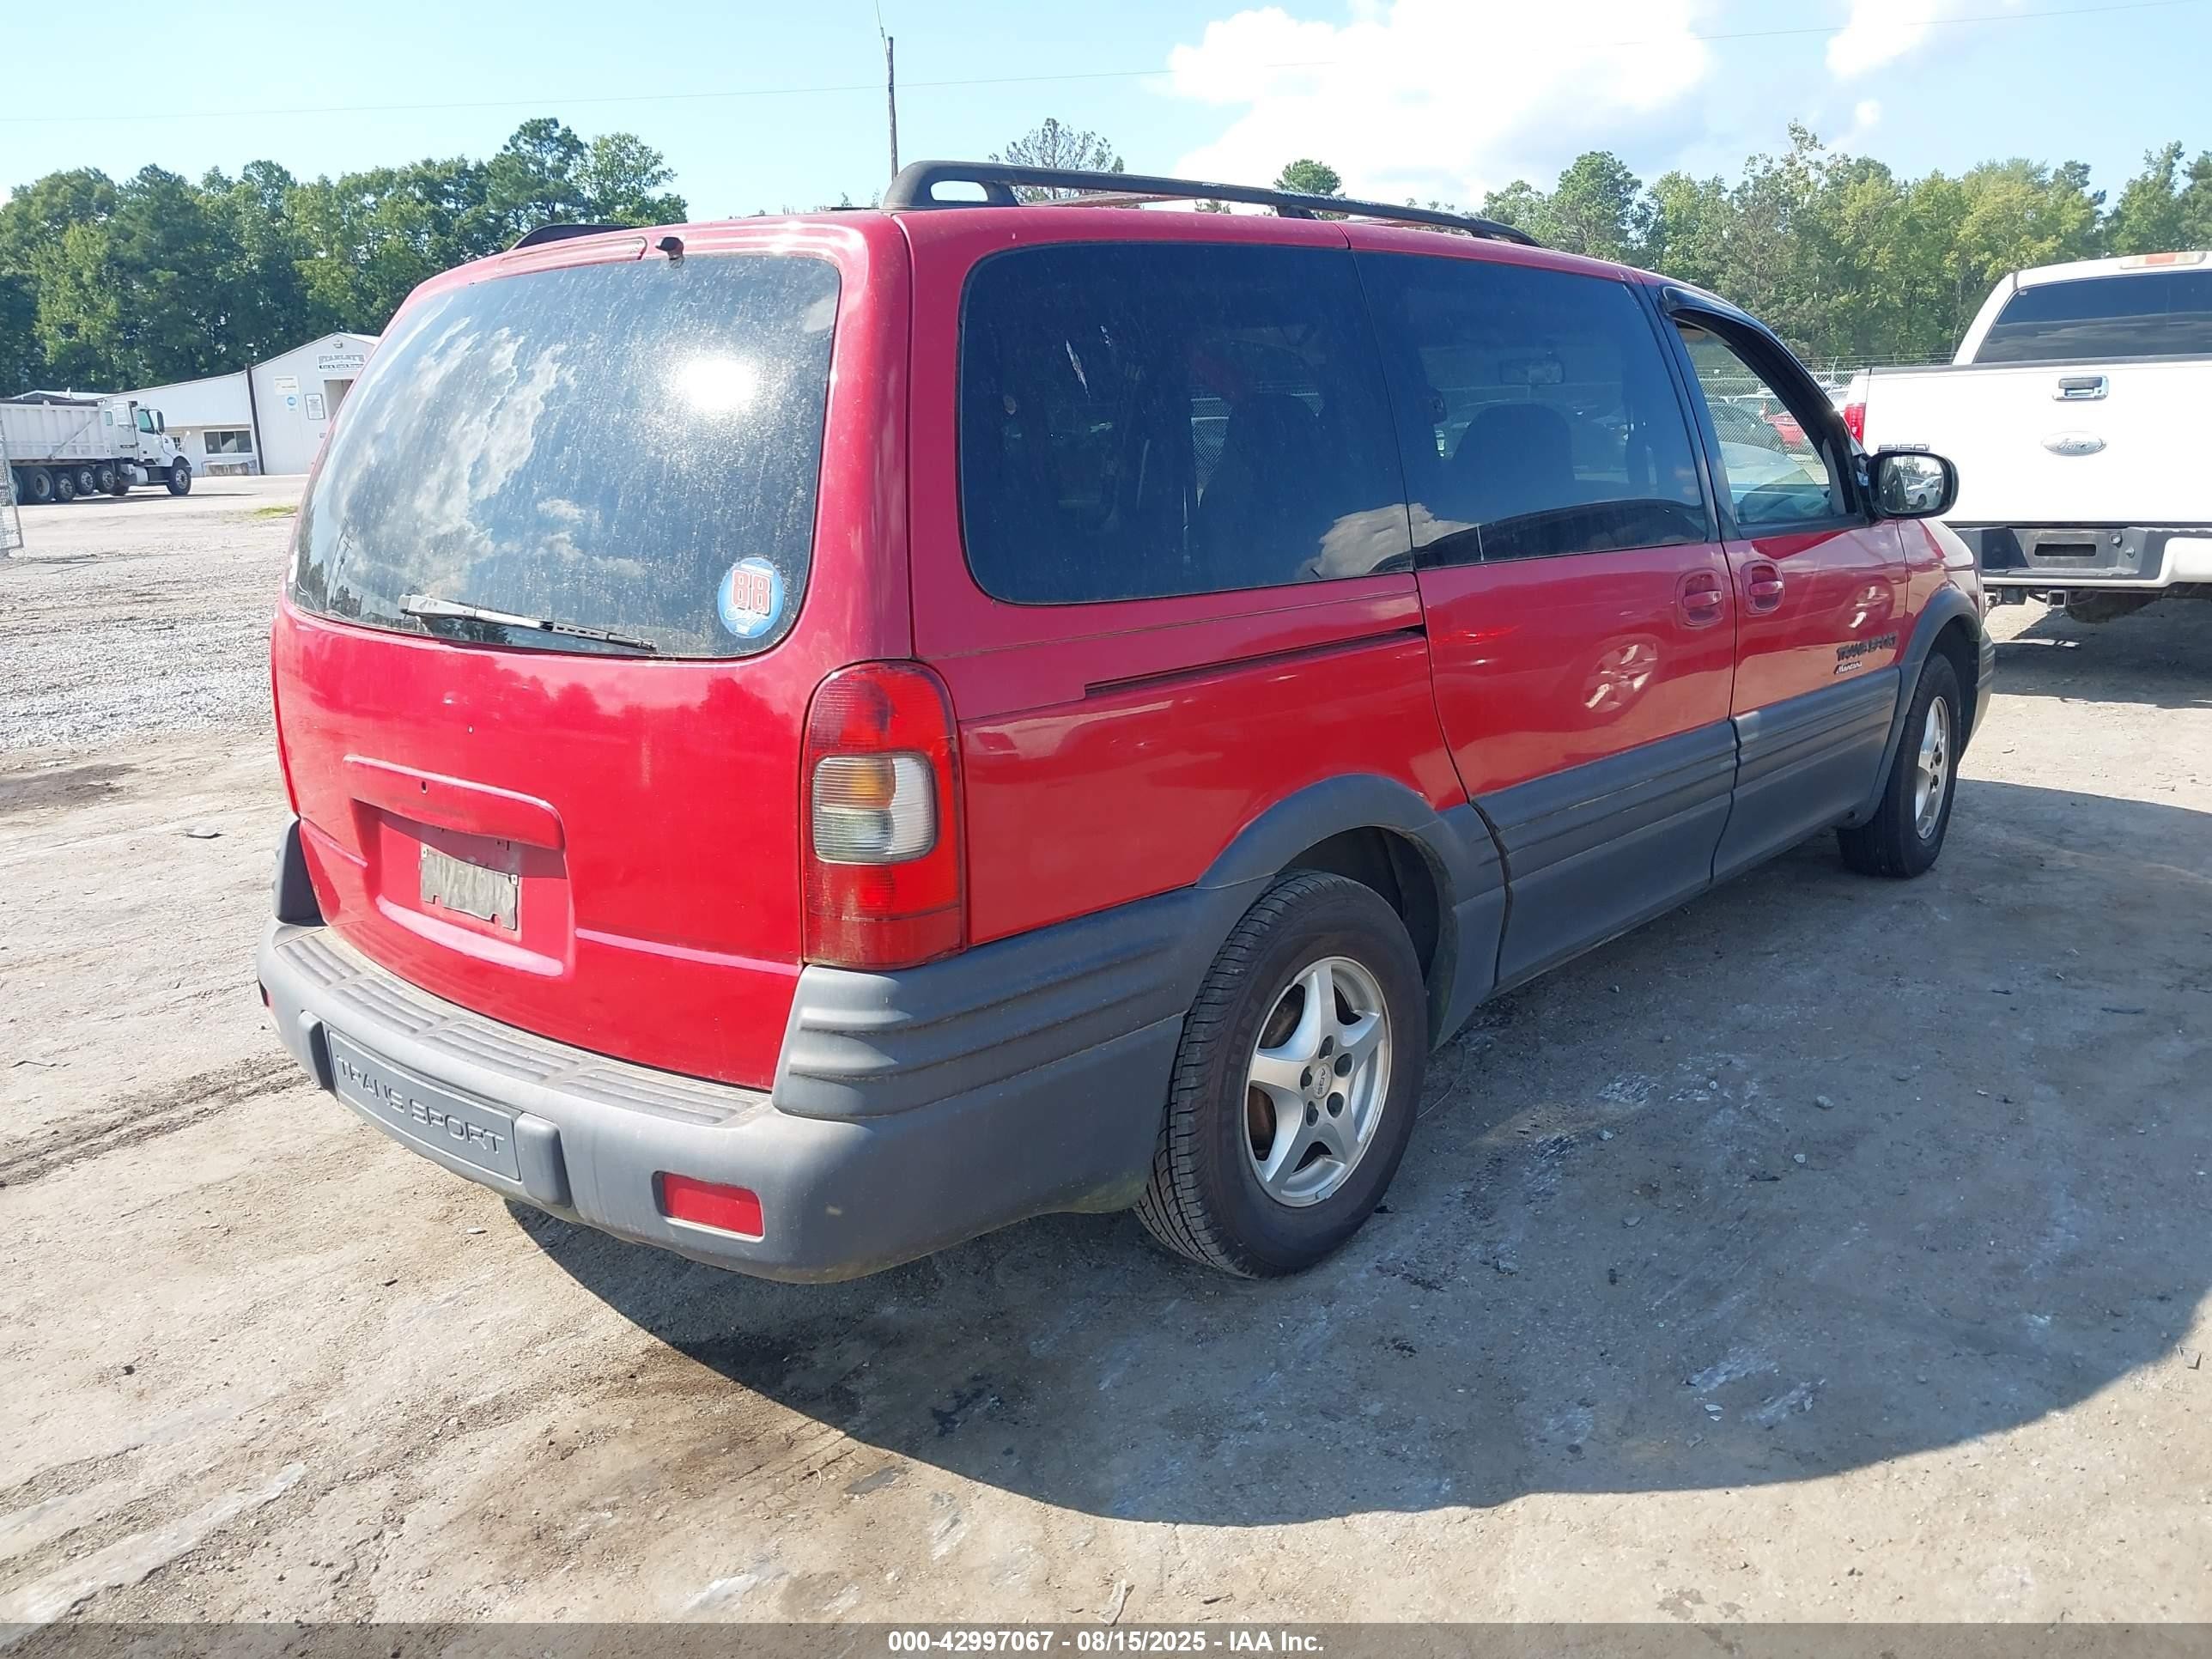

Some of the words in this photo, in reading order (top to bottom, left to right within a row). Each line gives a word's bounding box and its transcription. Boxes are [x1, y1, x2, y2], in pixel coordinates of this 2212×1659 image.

[731, 569, 771, 617] 88
[337, 1054, 405, 1114] TRANS
[410, 1098, 505, 1155] SPORT
